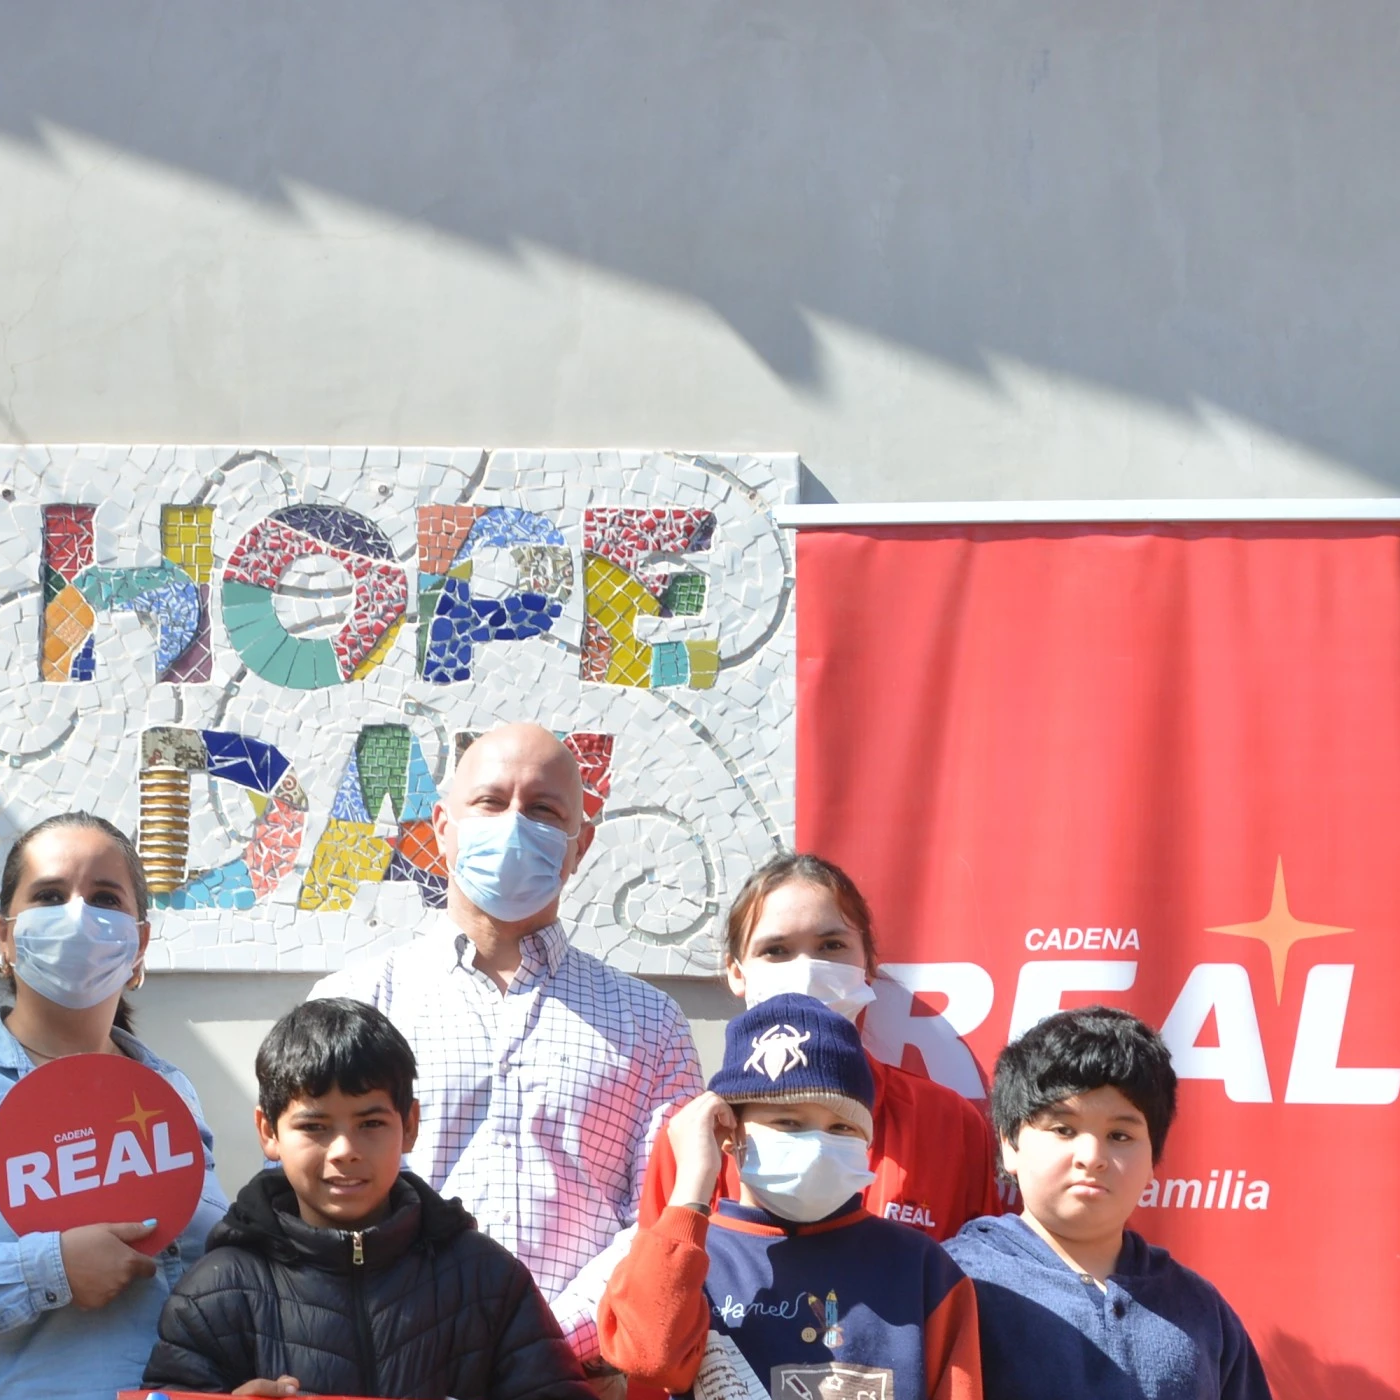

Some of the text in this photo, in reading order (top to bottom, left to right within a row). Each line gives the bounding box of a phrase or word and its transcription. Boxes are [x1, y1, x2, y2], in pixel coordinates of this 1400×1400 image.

[41, 502, 719, 688] HOPE
[1024, 928, 1141, 951] CADENA
[54, 1126, 94, 1144] CADENA
[6, 1121, 194, 1208] REAL
[1137, 1169, 1270, 1211] amilia
[883, 1201, 936, 1227] REAL
